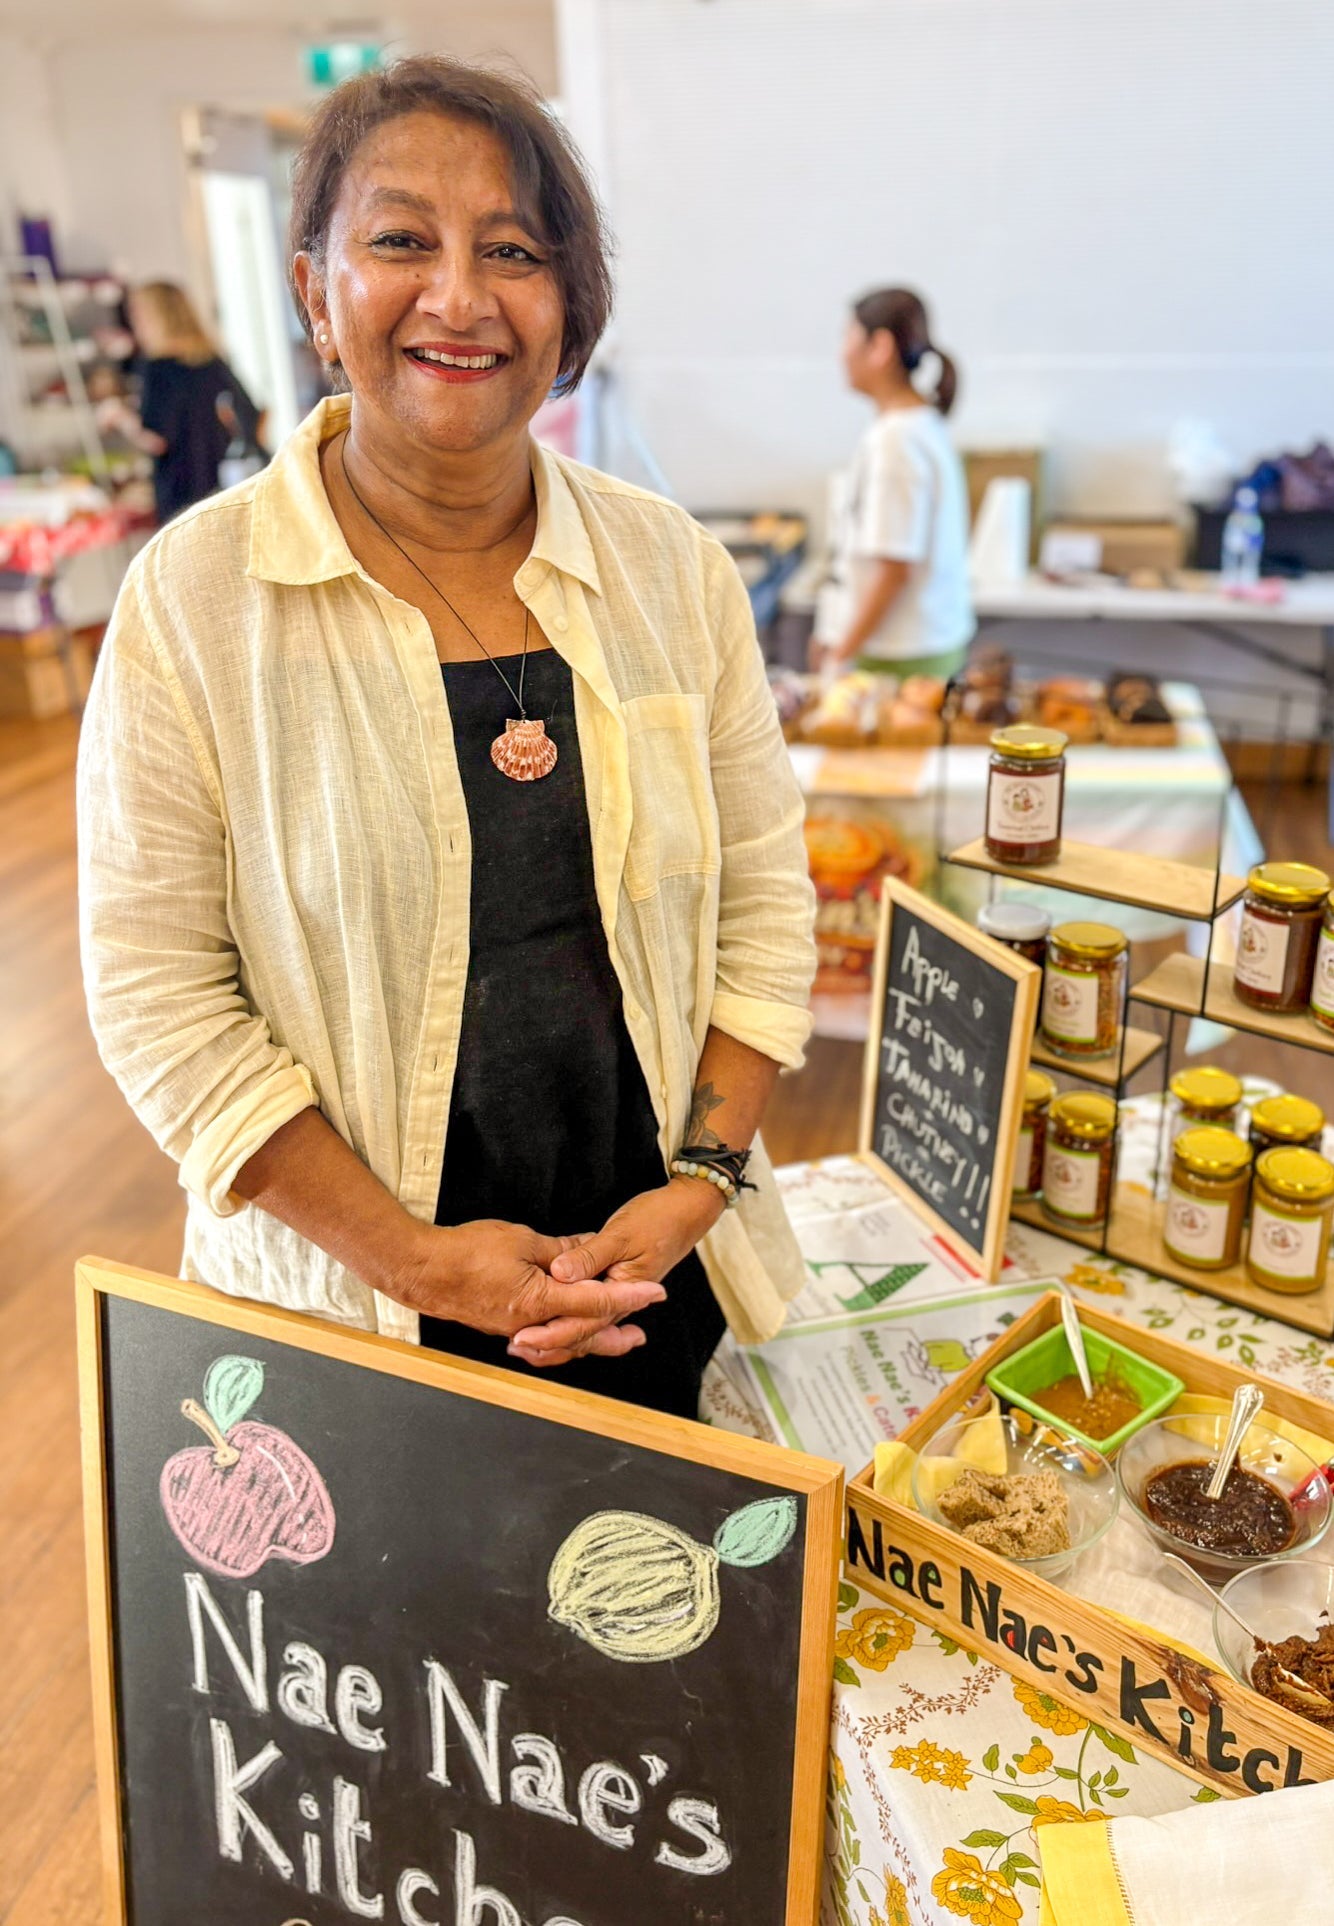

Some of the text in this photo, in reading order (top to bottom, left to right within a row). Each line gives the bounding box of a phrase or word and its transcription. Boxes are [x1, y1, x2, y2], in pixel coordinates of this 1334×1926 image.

[846, 1507, 946, 1611] Nae
[960, 1566, 1105, 1694] Nae's
[184, 1571, 733, 1877] Nae Nae's
[209, 1717, 585, 1926] Kitch
